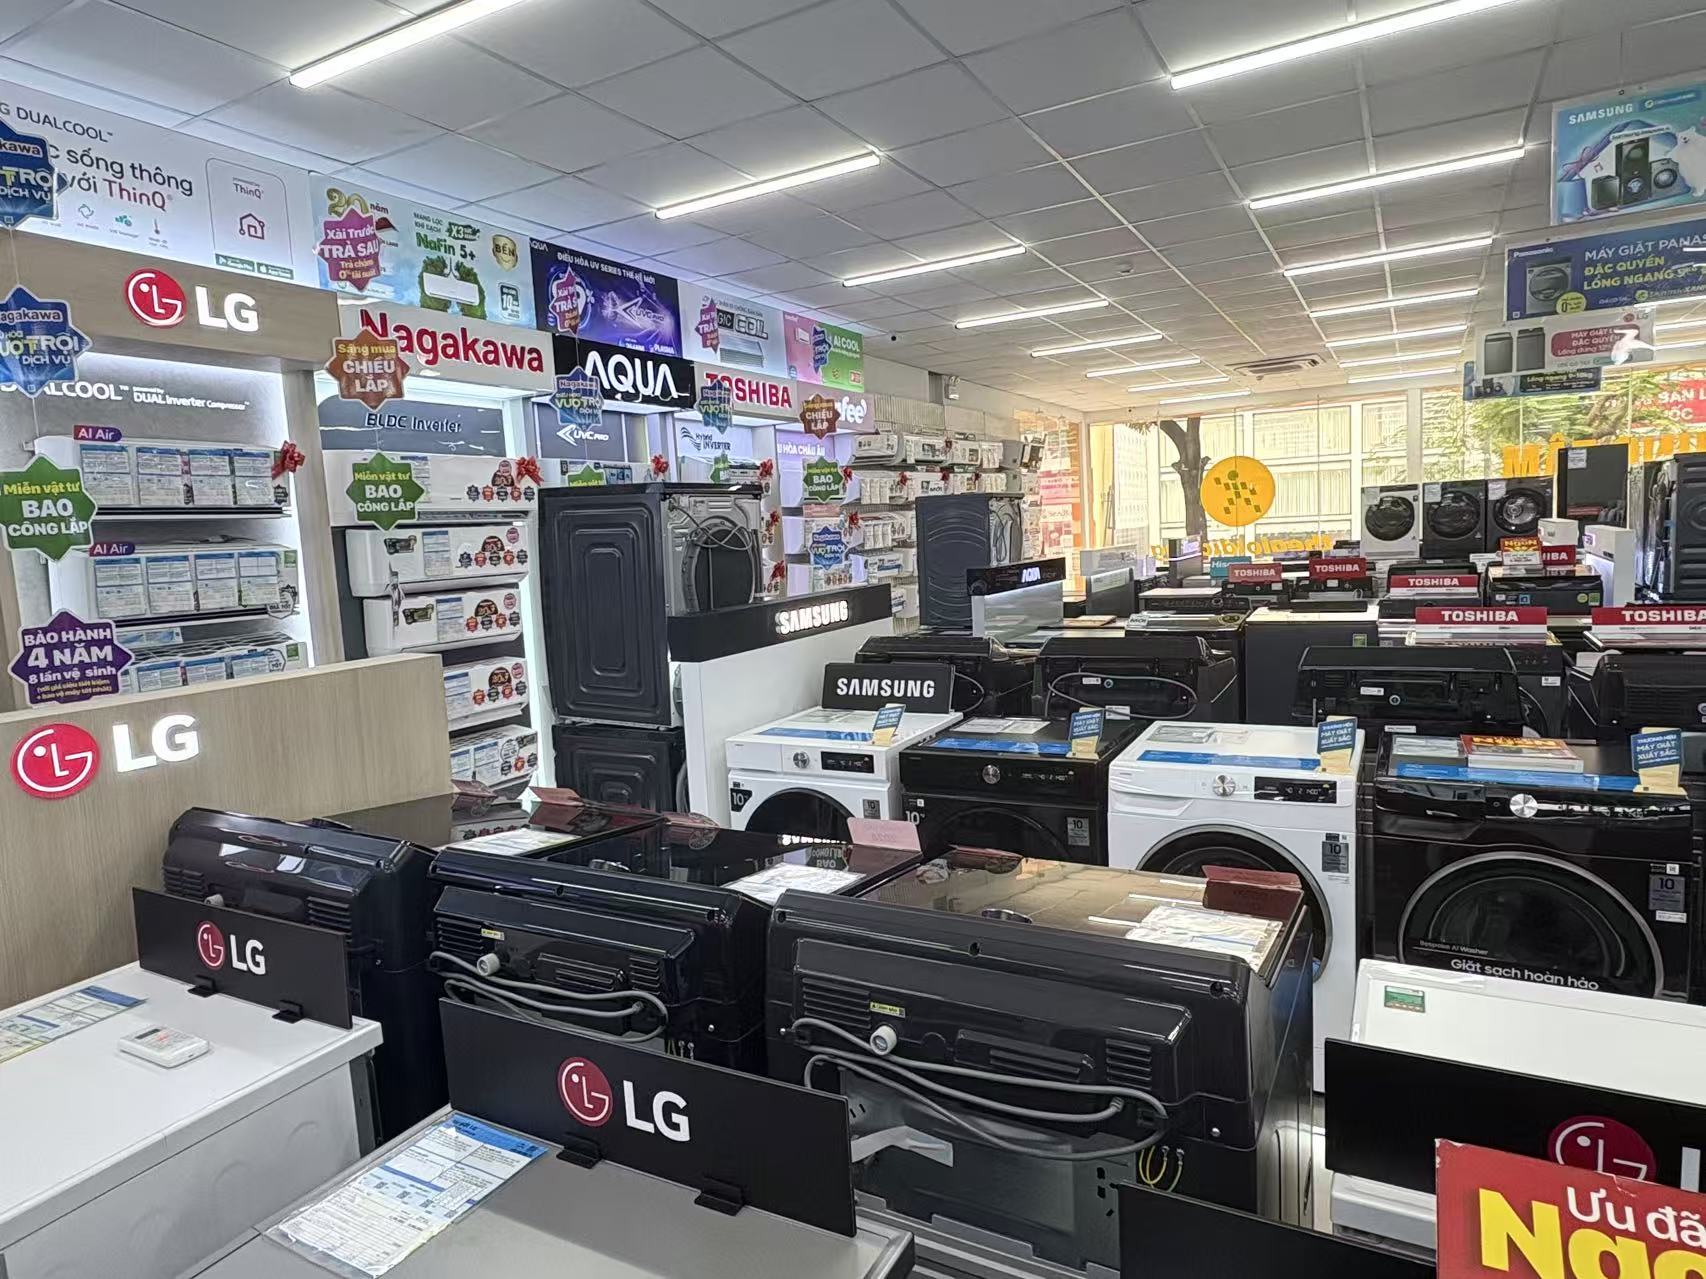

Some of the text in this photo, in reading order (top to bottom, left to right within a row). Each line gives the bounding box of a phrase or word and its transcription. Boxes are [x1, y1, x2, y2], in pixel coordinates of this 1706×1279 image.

[1569, 103, 1633, 125] SAMSUNG
[67, 148, 124, 179] sống
[130, 162, 194, 197] thông
[370, 203, 389, 215] năm
[357, 239, 381, 257] SAU
[460, 244, 476, 261] 5+
[1584, 246, 1616, 262] MÁY
[195, 285, 260, 332] LG
[717, 311, 769, 340] GIC COIL
[360, 309, 545, 374] Nagakawa
[370, 343, 396, 354] mua
[585, 350, 679, 400] AQUA
[704, 371, 793, 409] TOSHIBA
[134, 392, 165, 405] DUAL
[365, 411, 462, 433] BLDC Inverter
[78, 428, 114, 440] AI Air
[813, 475, 834, 484] BAO
[4, 480, 81, 496] Miễn vật tư
[365, 484, 402, 499] BAO
[21, 498, 74, 519] BAO
[357, 501, 390, 512] CÔNG
[8, 519, 59, 537] CÔNG
[94, 543, 129, 556] AI Air
[1234, 568, 1276, 578] TOSHIBA
[1315, 563, 1360, 574] TOSHIBA
[1408, 578, 1460, 587] TOSHIBA
[775, 600, 850, 636] SAMSUNG
[1441, 610, 1520, 623] TOSHIBA
[1621, 610, 1706, 623] TOSHIBA
[61, 627, 112, 643] HÀNH
[27, 642, 113, 668] 4 NĂM
[28, 674, 39, 685] 8
[85, 666, 117, 678] sinh
[836, 676, 935, 698] SAMSUNG
[112, 713, 200, 774] LG
[732, 792, 744, 806] 10
[905, 811, 920, 826] 10
[1072, 818, 1083, 830] 10
[1329, 843, 1341, 855] 10
[1658, 877, 1675, 890] 10
[229, 934, 267, 976] LG
[1459, 946, 1489, 956] Washer
[1451, 958, 1599, 991] Giặt sạch hoàn hảo
[622, 1080, 691, 1142] LG
[1566, 1186, 1637, 1232] Ưu
